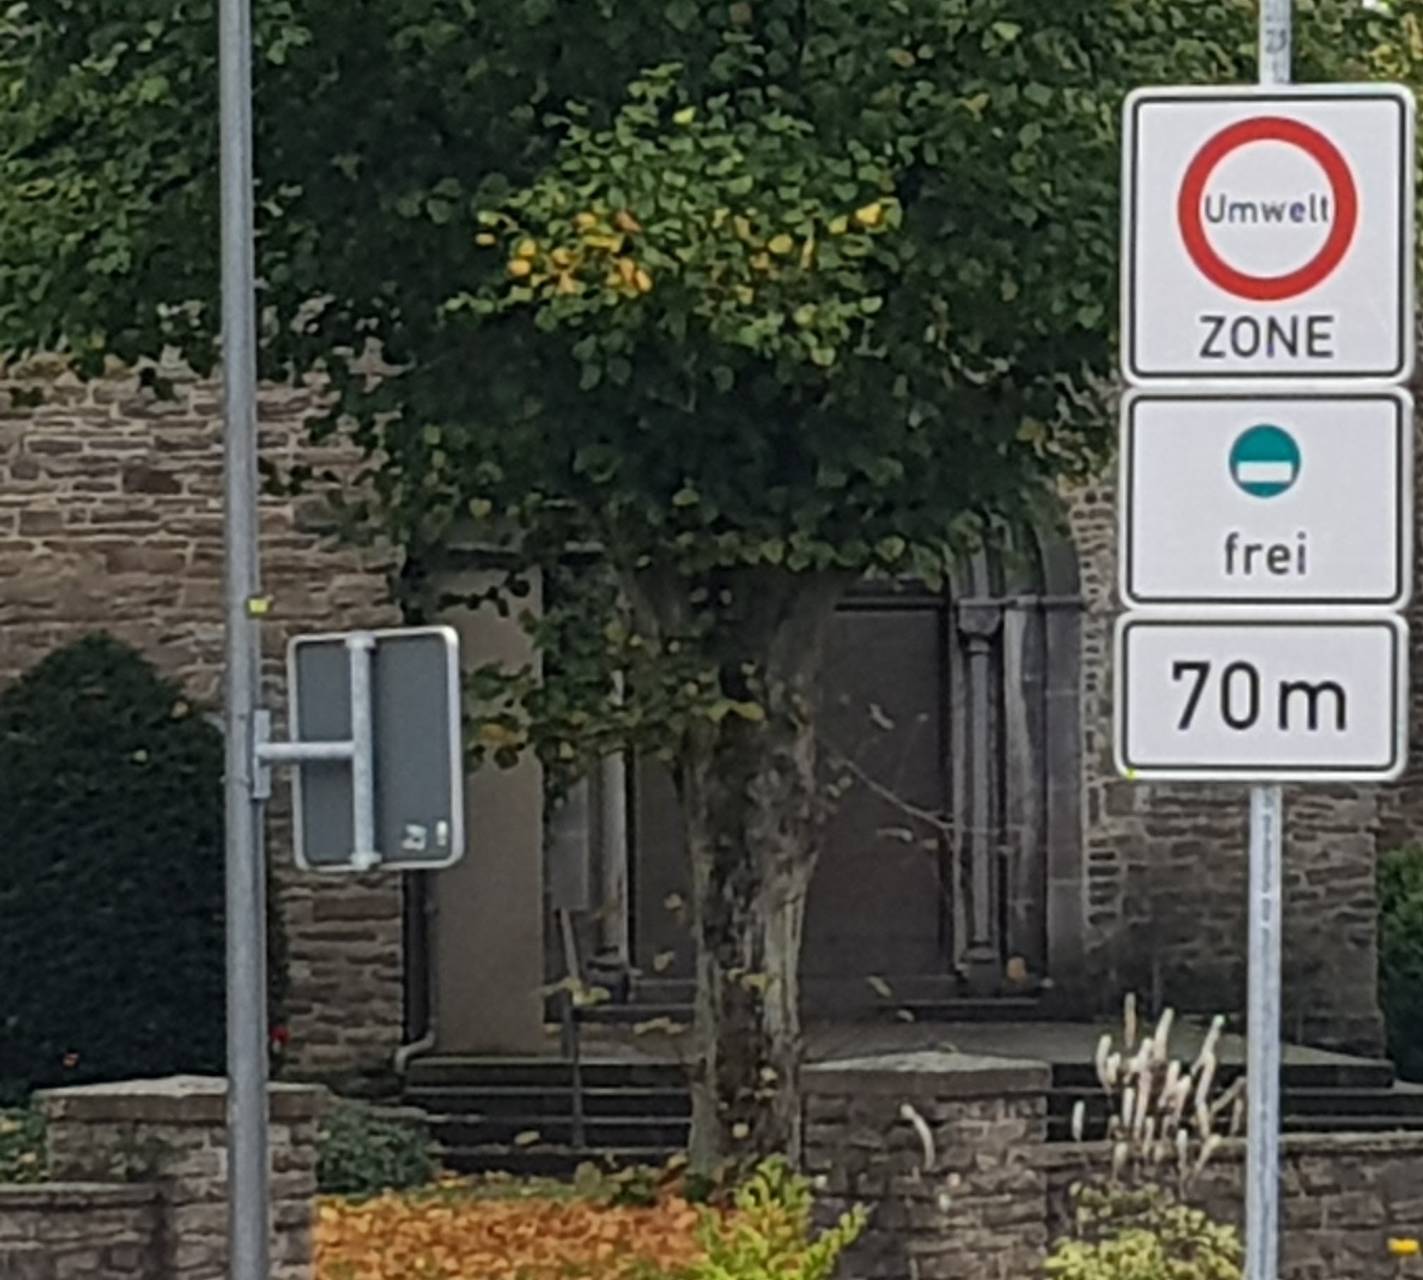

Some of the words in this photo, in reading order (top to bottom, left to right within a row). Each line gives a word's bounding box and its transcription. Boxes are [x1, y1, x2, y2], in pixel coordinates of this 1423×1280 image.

[1204, 193, 1329, 223] Umwelt
[1199, 315, 1334, 358] ZONE
[1224, 531, 1307, 575] frei
[1171, 660, 1261, 731] 70
[1277, 680, 1347, 731] m
